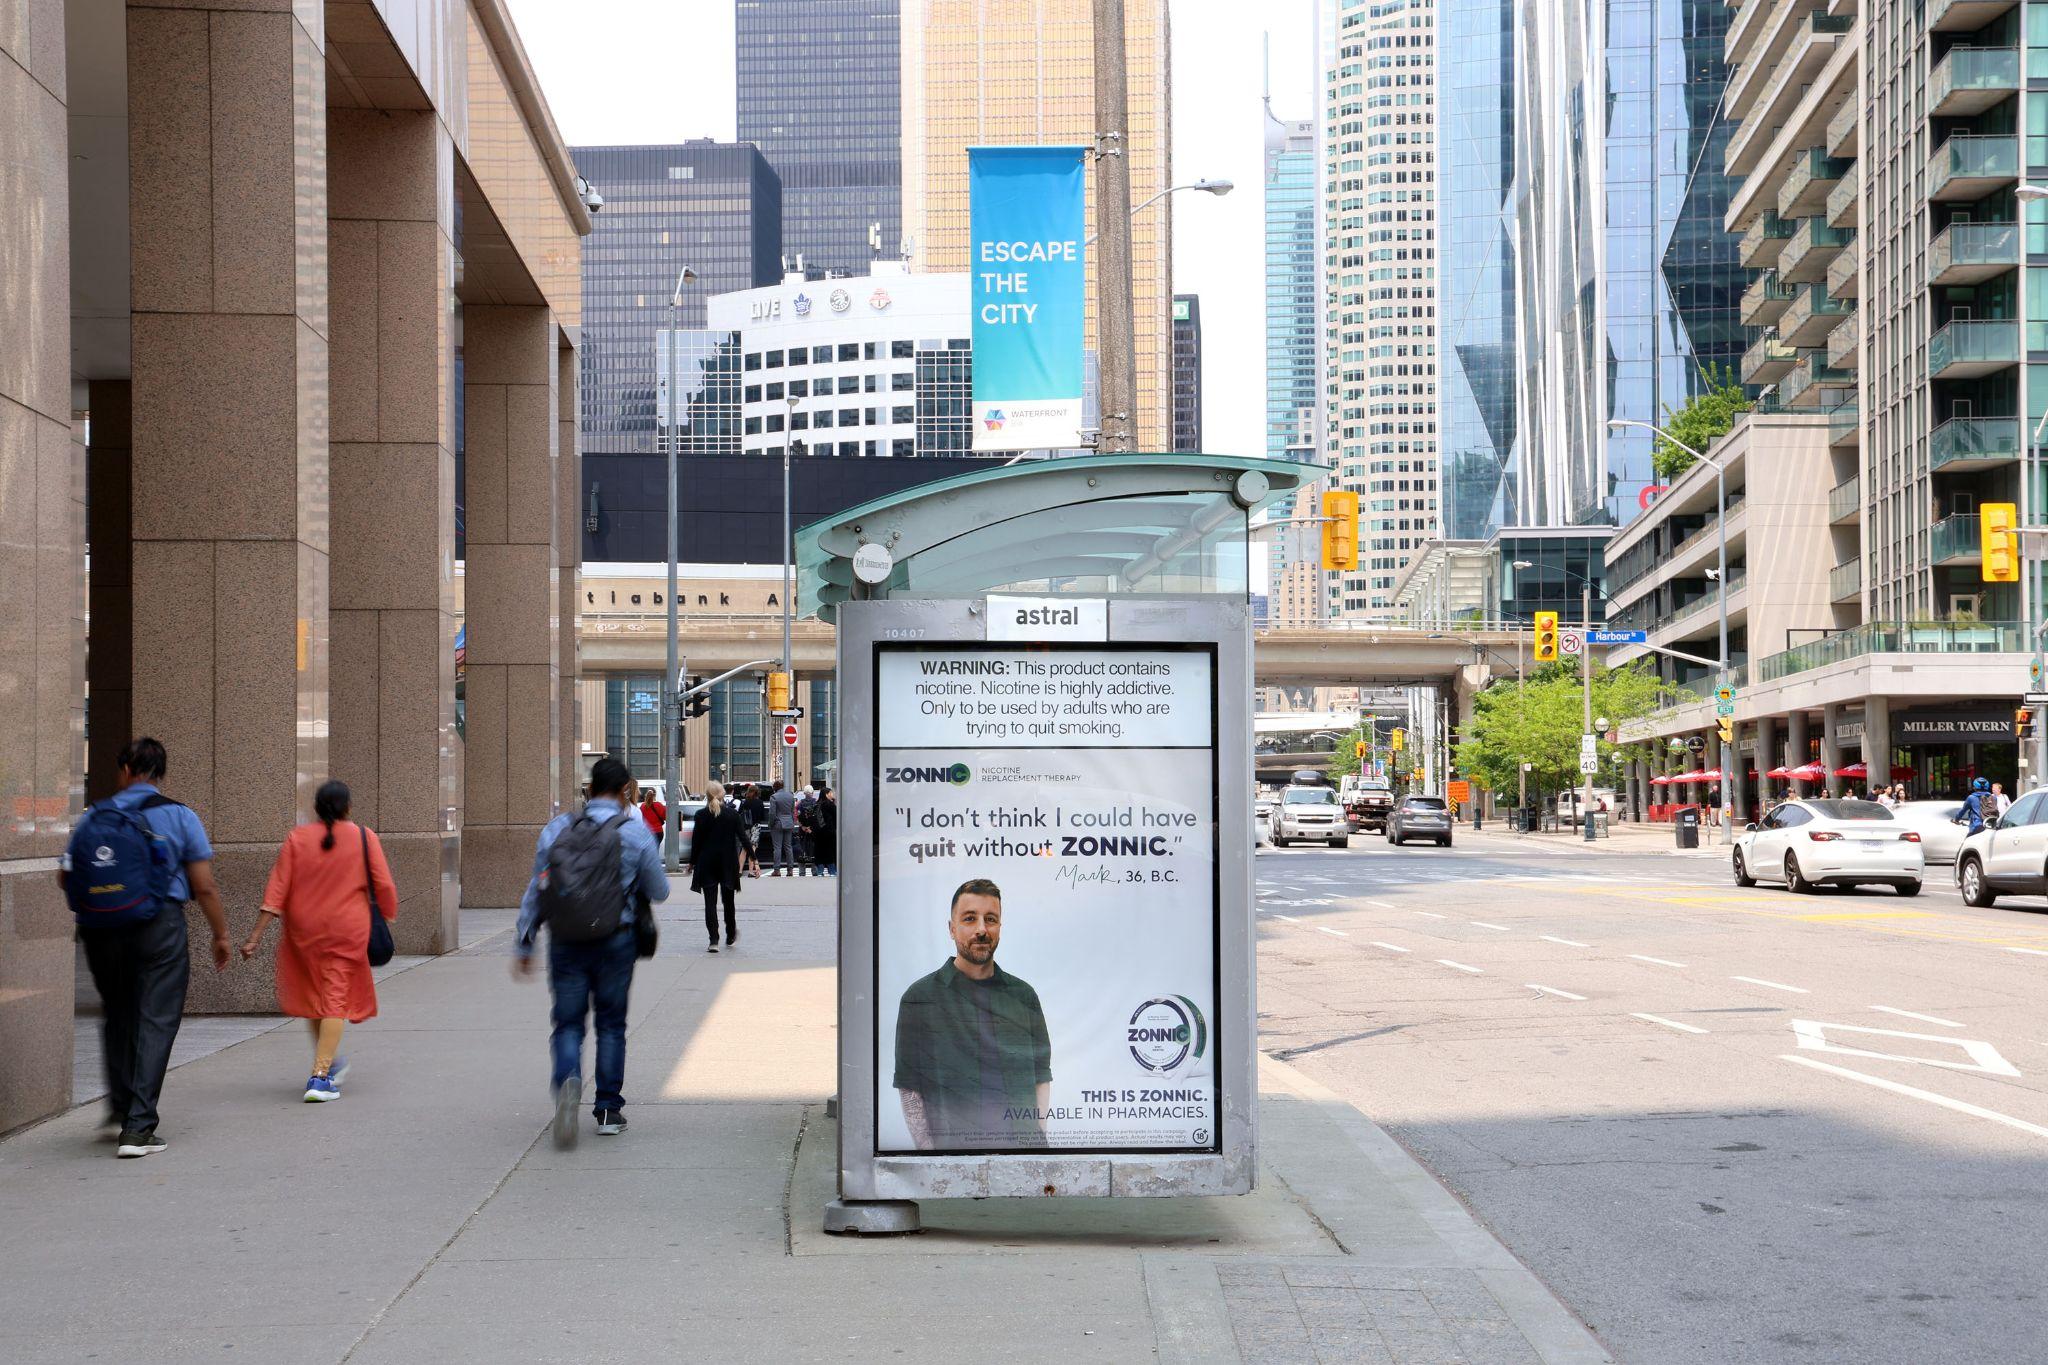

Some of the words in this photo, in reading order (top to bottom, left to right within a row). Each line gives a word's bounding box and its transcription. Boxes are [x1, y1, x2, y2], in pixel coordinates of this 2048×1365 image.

[981, 241, 1077, 262] ESCAPE
[980, 273, 1028, 293] THE
[981, 304, 1038, 324] CITY
[1011, 408, 1068, 418] WATERFRONT
[1016, 606, 1079, 625] astral
[885, 629, 924, 638] 10407
[1596, 632, 1630, 641] Harbour
[920, 660, 1010, 675] WARNING:
[1014, 660, 1046, 675] This
[1050, 661, 1106, 678] product
[1108, 661, 1171, 675] contains
[915, 681, 976, 695] nicotine.
[981, 681, 1040, 695] Nicotine
[1044, 681, 1056, 695] is
[1060, 681, 1103, 698] highly
[1107, 681, 1175, 695] addictive.
[921, 700, 956, 718] Only
[960, 701, 974, 715] to
[977, 701, 997, 715] be
[1001, 701, 1037, 715] used
[1041, 701, 1060, 718] by
[1063, 700, 1107, 715] adults
[1111, 701, 1142, 715] who
[1146, 703, 1170, 715] are
[966, 721, 1006, 738] trying
[1010, 721, 1025, 735] to
[1028, 721, 1055, 738] quit
[1059, 721, 1125, 738] smoking.
[1903, 722, 1956, 732] MILLER
[1957, 721, 2011, 732] TAVERN
[1582, 761, 1596, 771] 40
[886, 767, 967, 783] ZONNIC
[988, 807, 1048, 828] think
[1056, 807, 1061, 828] I
[1070, 807, 1133, 827] could
[1142, 807, 1198, 827] have
[909, 837, 956, 863] quit
[963, 837, 1054, 857] without
[1125, 870, 1147, 884] 36,
[1151, 870, 1179, 883] B.C.
[1128, 1028, 1189, 1042] ZONNIC
[1081, 1090, 1117, 1103] THIS
[1121, 1090, 1136, 1102] IS
[1140, 1089, 1208, 1103] ZONNIC.
[1003, 1107, 1083, 1120] AVAILABLE
[1088, 1108, 1103, 1119] IN
[1108, 1106, 1208, 1119] PHARMACIES.
